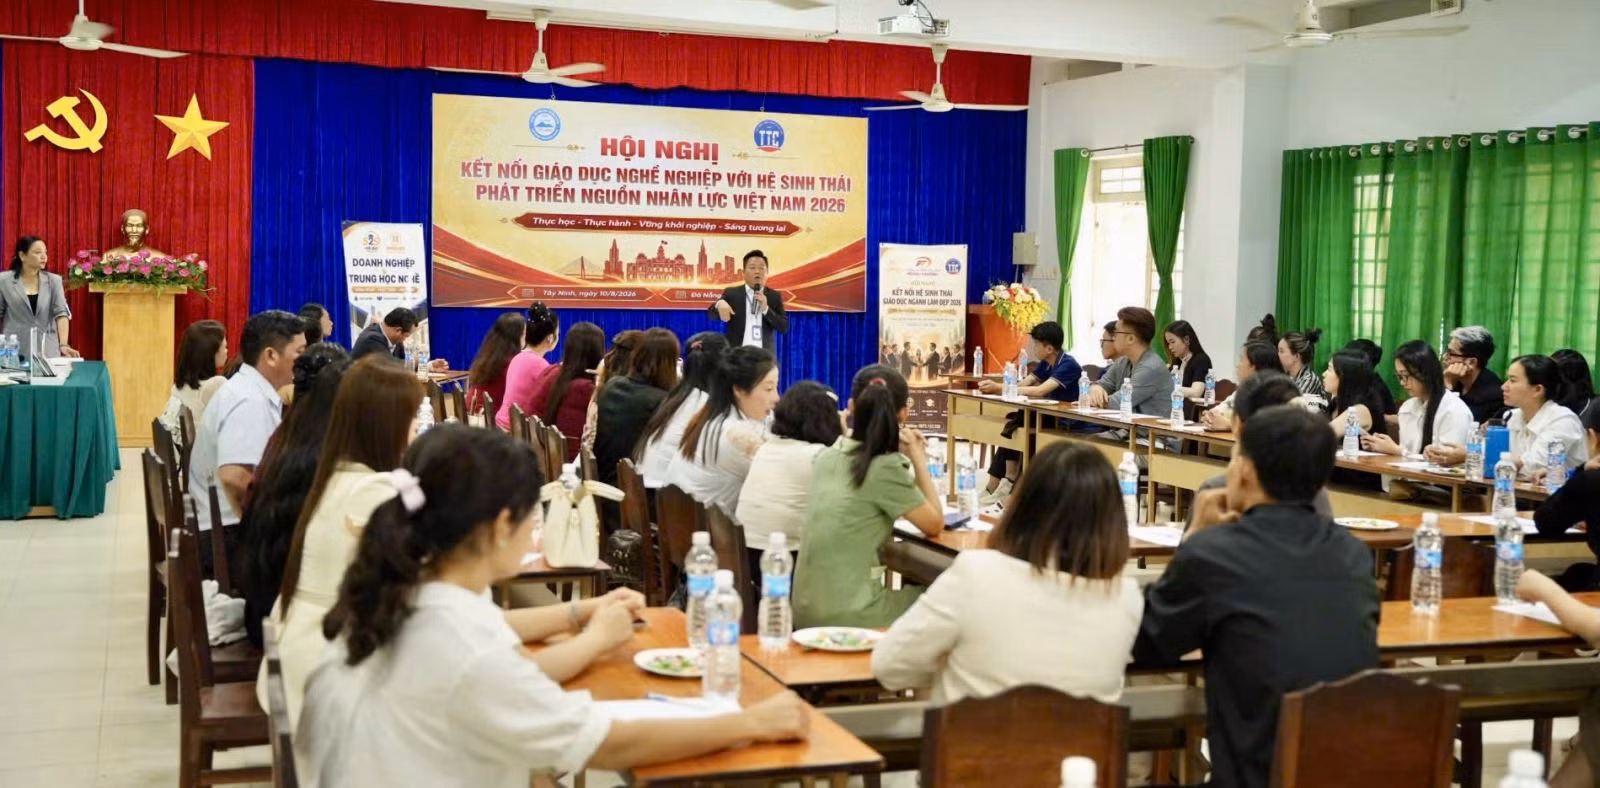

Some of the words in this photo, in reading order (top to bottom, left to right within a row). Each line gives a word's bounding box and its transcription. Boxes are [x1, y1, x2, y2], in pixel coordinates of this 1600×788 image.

[759, 130, 780, 146] TTC
[600, 135, 645, 161] HỘI
[655, 140, 719, 165] NGHỊ
[461, 157, 492, 178] KẾT
[497, 158, 527, 180] NỐI
[533, 162, 573, 181] GIÁO
[578, 166, 611, 184] DỤC
[616, 164, 659, 185] NGHỀ
[664, 169, 721, 190] NGHIỆP
[727, 170, 751, 189] VỚI
[757, 172, 776, 192] HỆ
[780, 175, 815, 191] SINH
[819, 173, 851, 193] THÁI
[476, 182, 520, 201] PHÁT
[525, 181, 575, 203] TRIỂN
[581, 184, 641, 205] NGUỒN
[646, 189, 693, 207] NHÂN
[699, 192, 727, 212] LỰC
[733, 192, 767, 213] VIỆT
[771, 196, 806, 212] NAM
[810, 197, 846, 213] 2026
[533, 217, 556, 226] Thực
[558, 217, 576, 227] học
[584, 218, 607, 228] Thực
[608, 219, 631, 227] hành
[686, 222, 716, 231] nghiệp
[724, 222, 746, 232] Sáng
[352, 258, 383, 267] DOANH
[385, 257, 415, 270] NGHIỆP
[349, 274, 377, 283] TRUNG
[379, 275, 396, 285] HỌC
[543, 289, 556, 298] Tây
[579, 290, 597, 298] ngày
[924, 289, 938, 297] SINH
